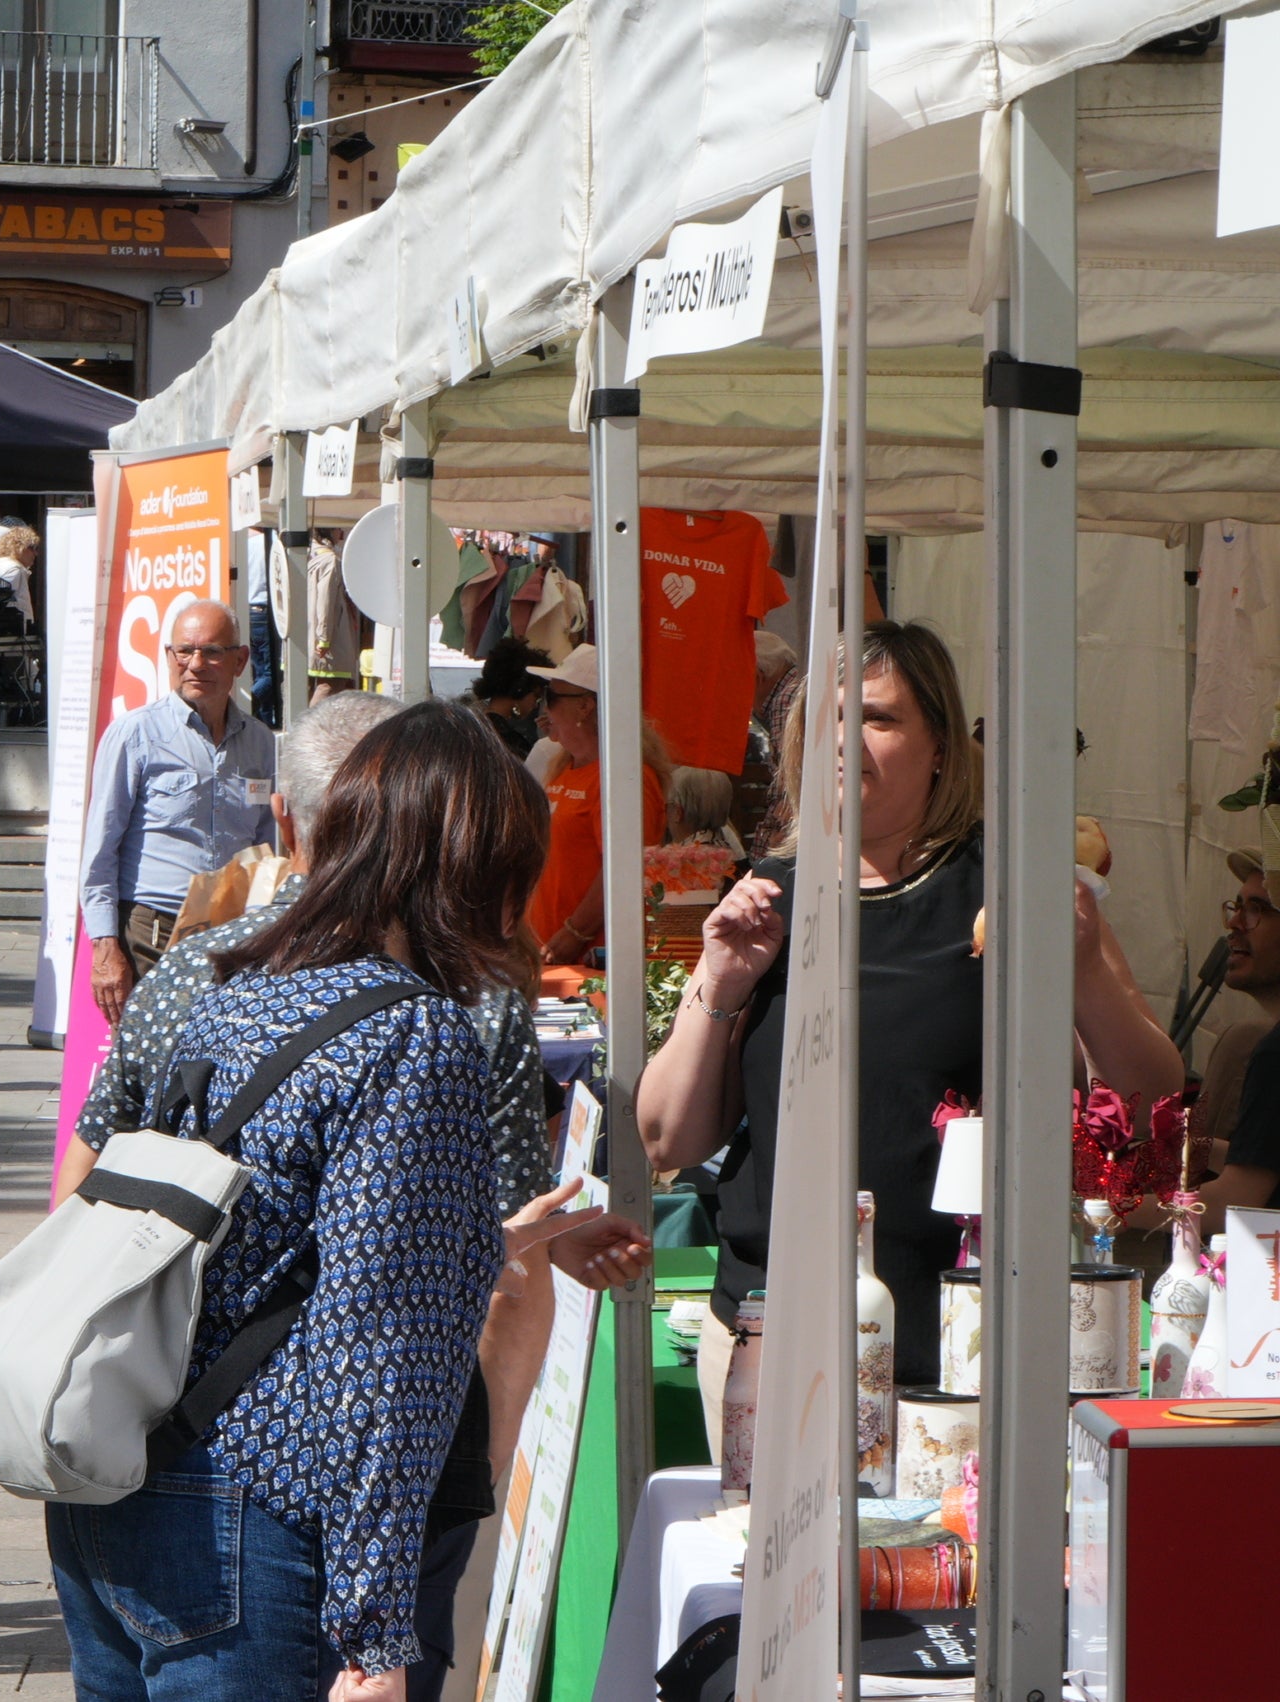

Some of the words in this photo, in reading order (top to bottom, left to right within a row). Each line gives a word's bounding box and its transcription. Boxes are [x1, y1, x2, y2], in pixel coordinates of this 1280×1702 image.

[111, 245, 136, 256] EXP.
[189, 291, 196, 305] 1
[123, 547, 152, 593] No
[153, 544, 206, 590] estàs
[644, 550, 690, 567] DONAR
[694, 558, 726, 574] VIDA
